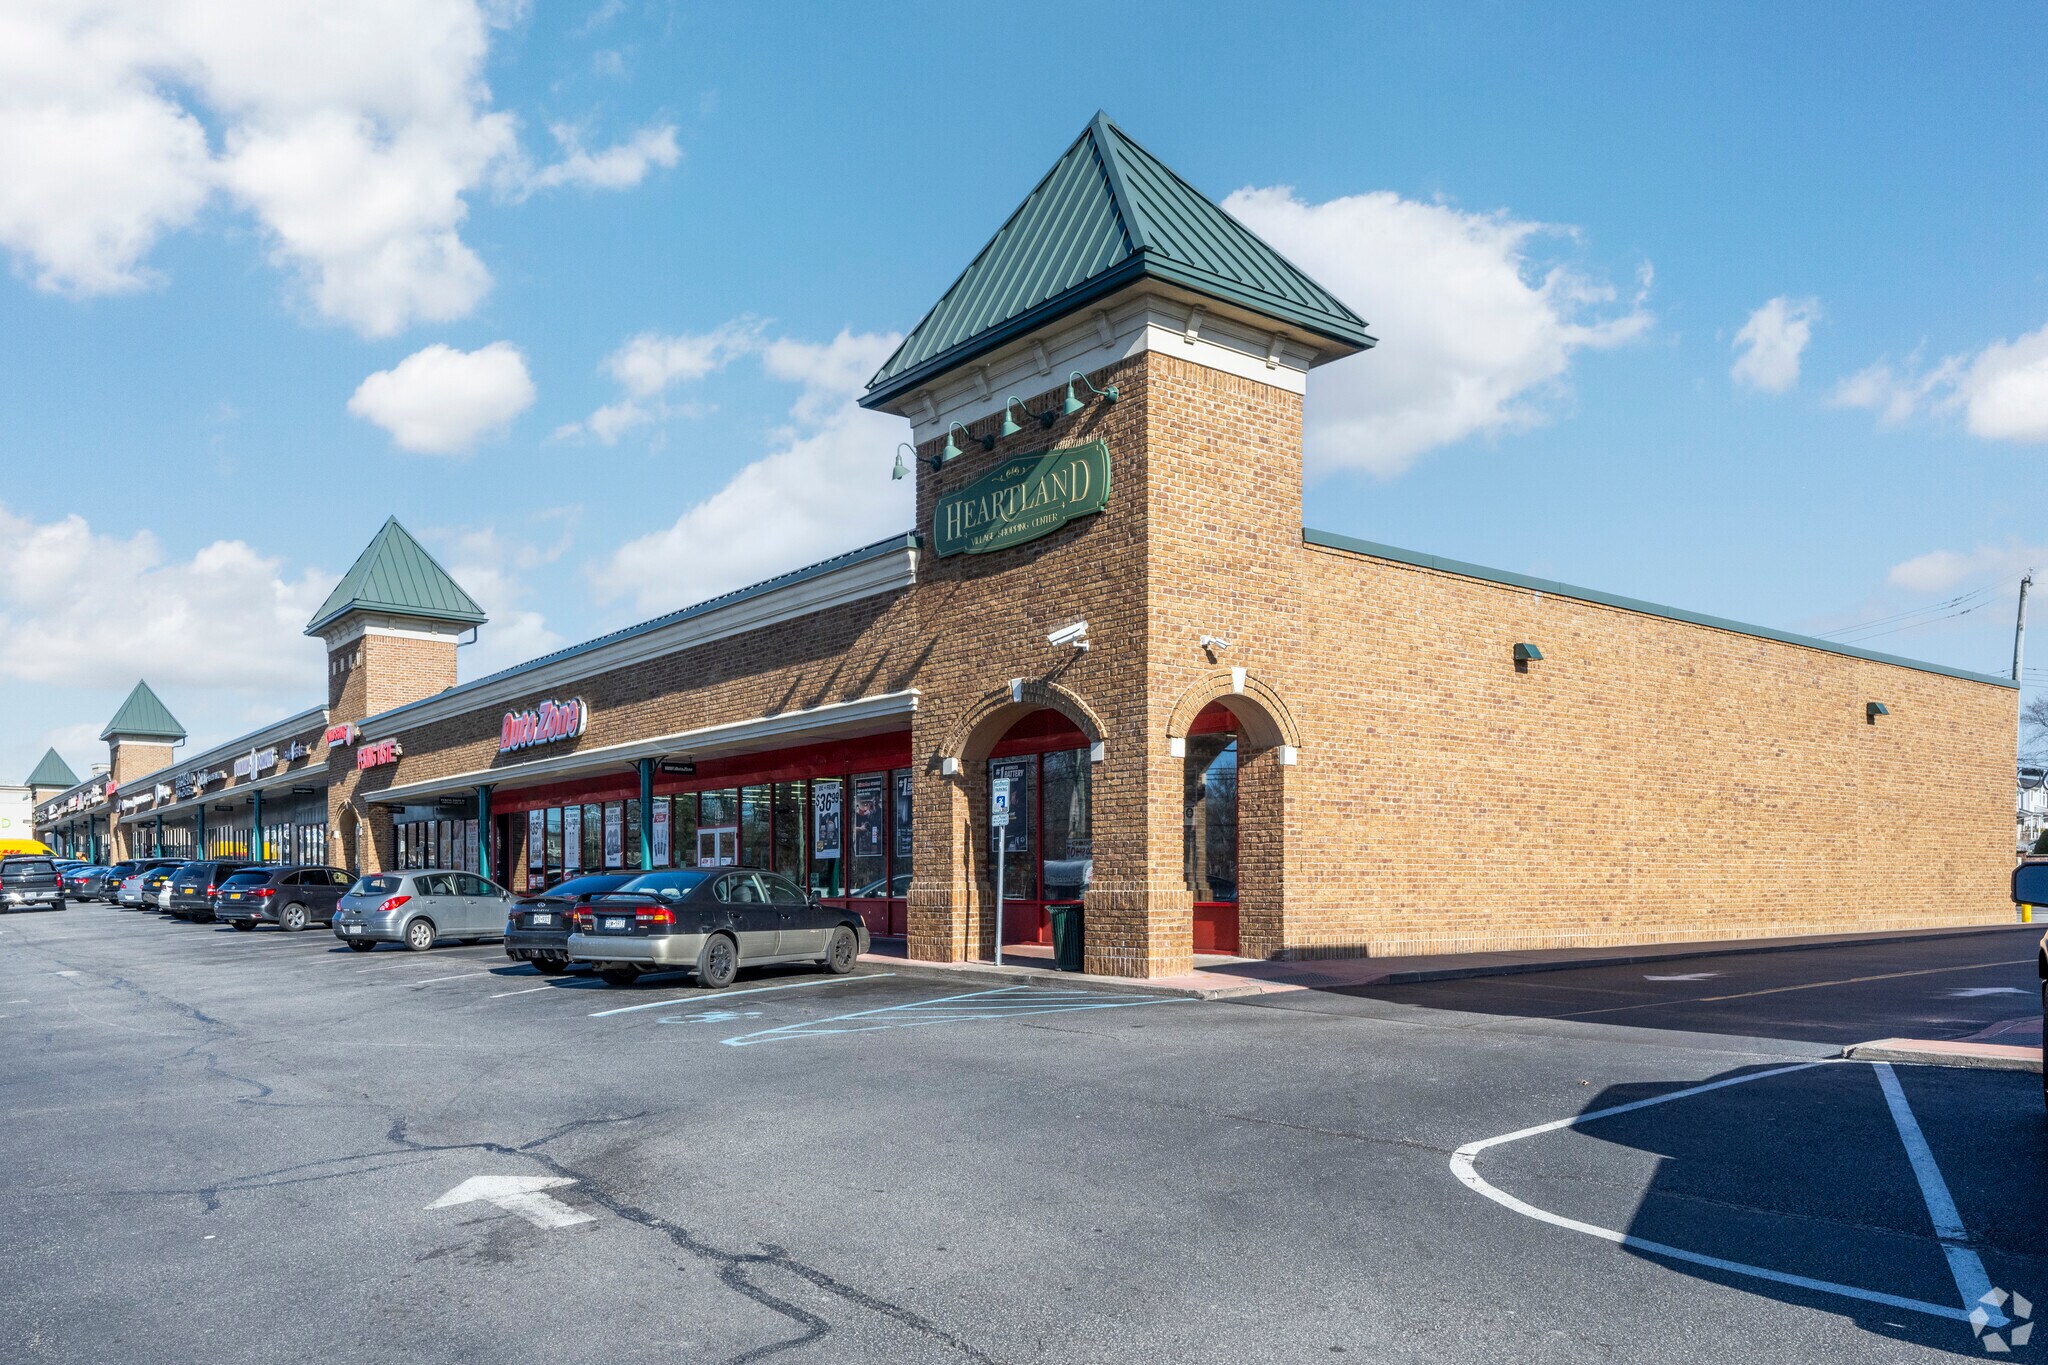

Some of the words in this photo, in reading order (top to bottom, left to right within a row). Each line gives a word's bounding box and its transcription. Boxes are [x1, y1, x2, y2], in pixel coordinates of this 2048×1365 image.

[946, 459, 1091, 541] HEARTLAND
[971, 533, 993, 546] VILLAGE
[998, 524, 1030, 539] SHOPPING
[1032, 513, 1058, 527] CENTER
[500, 698, 582, 752] AutoZone
[1004, 769, 1024, 778] BATTERY
